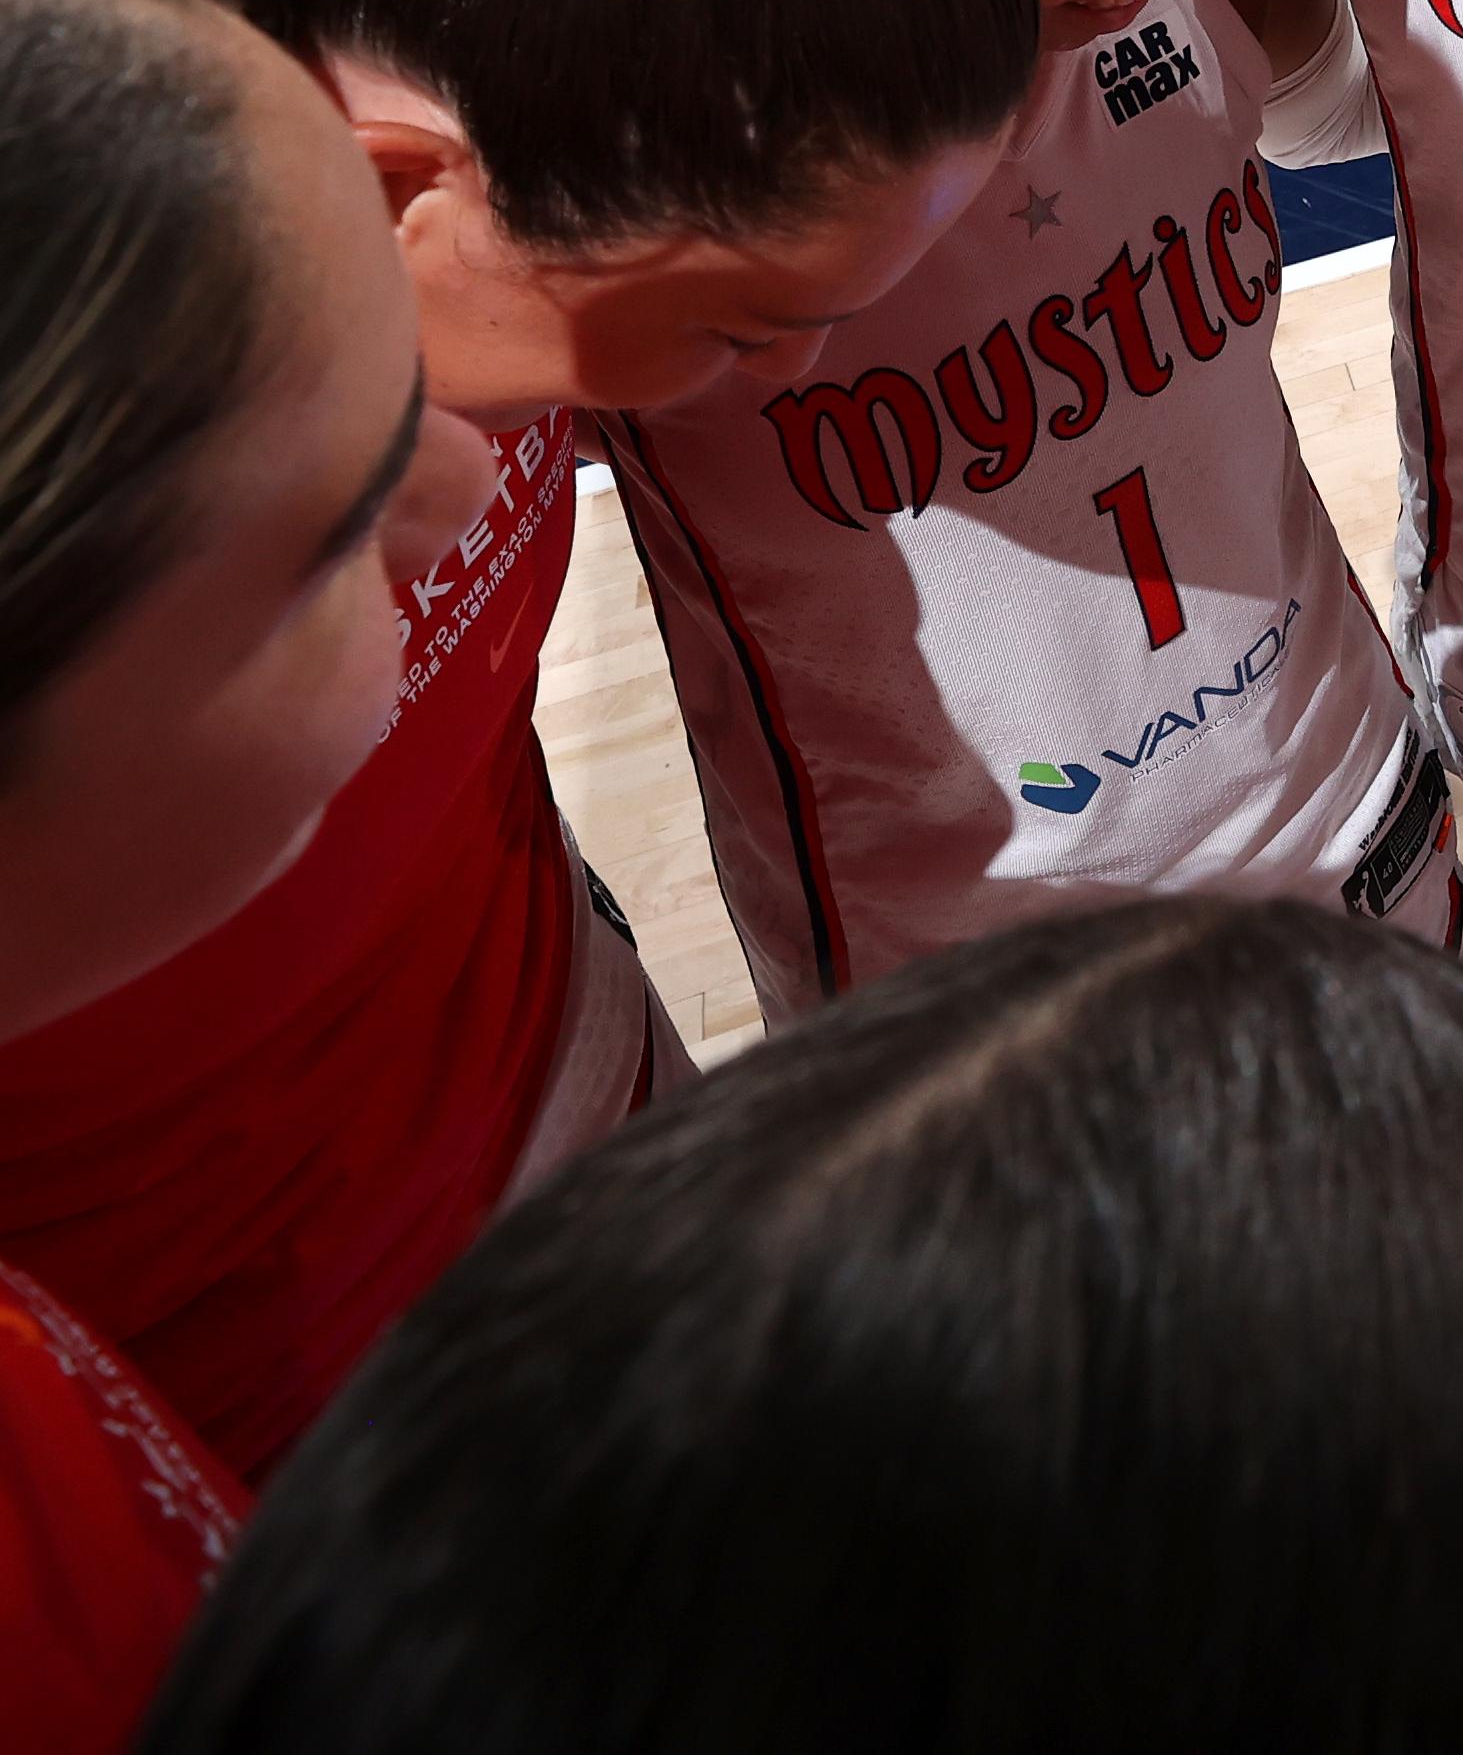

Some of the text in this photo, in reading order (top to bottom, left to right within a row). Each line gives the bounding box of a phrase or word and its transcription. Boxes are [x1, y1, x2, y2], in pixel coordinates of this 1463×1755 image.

[1094, 21, 1175, 90] CAR
[1102, 43, 1202, 128] max
[406, 655, 443, 703] THE
[442, 510, 543, 654] WASHINGTON
[424, 625, 448, 657] TO
[451, 575, 486, 621] THE
[488, 503, 534, 576] EXACT
[1092, 465, 1187, 652] 1
[1100, 598, 1302, 769] VANDA
